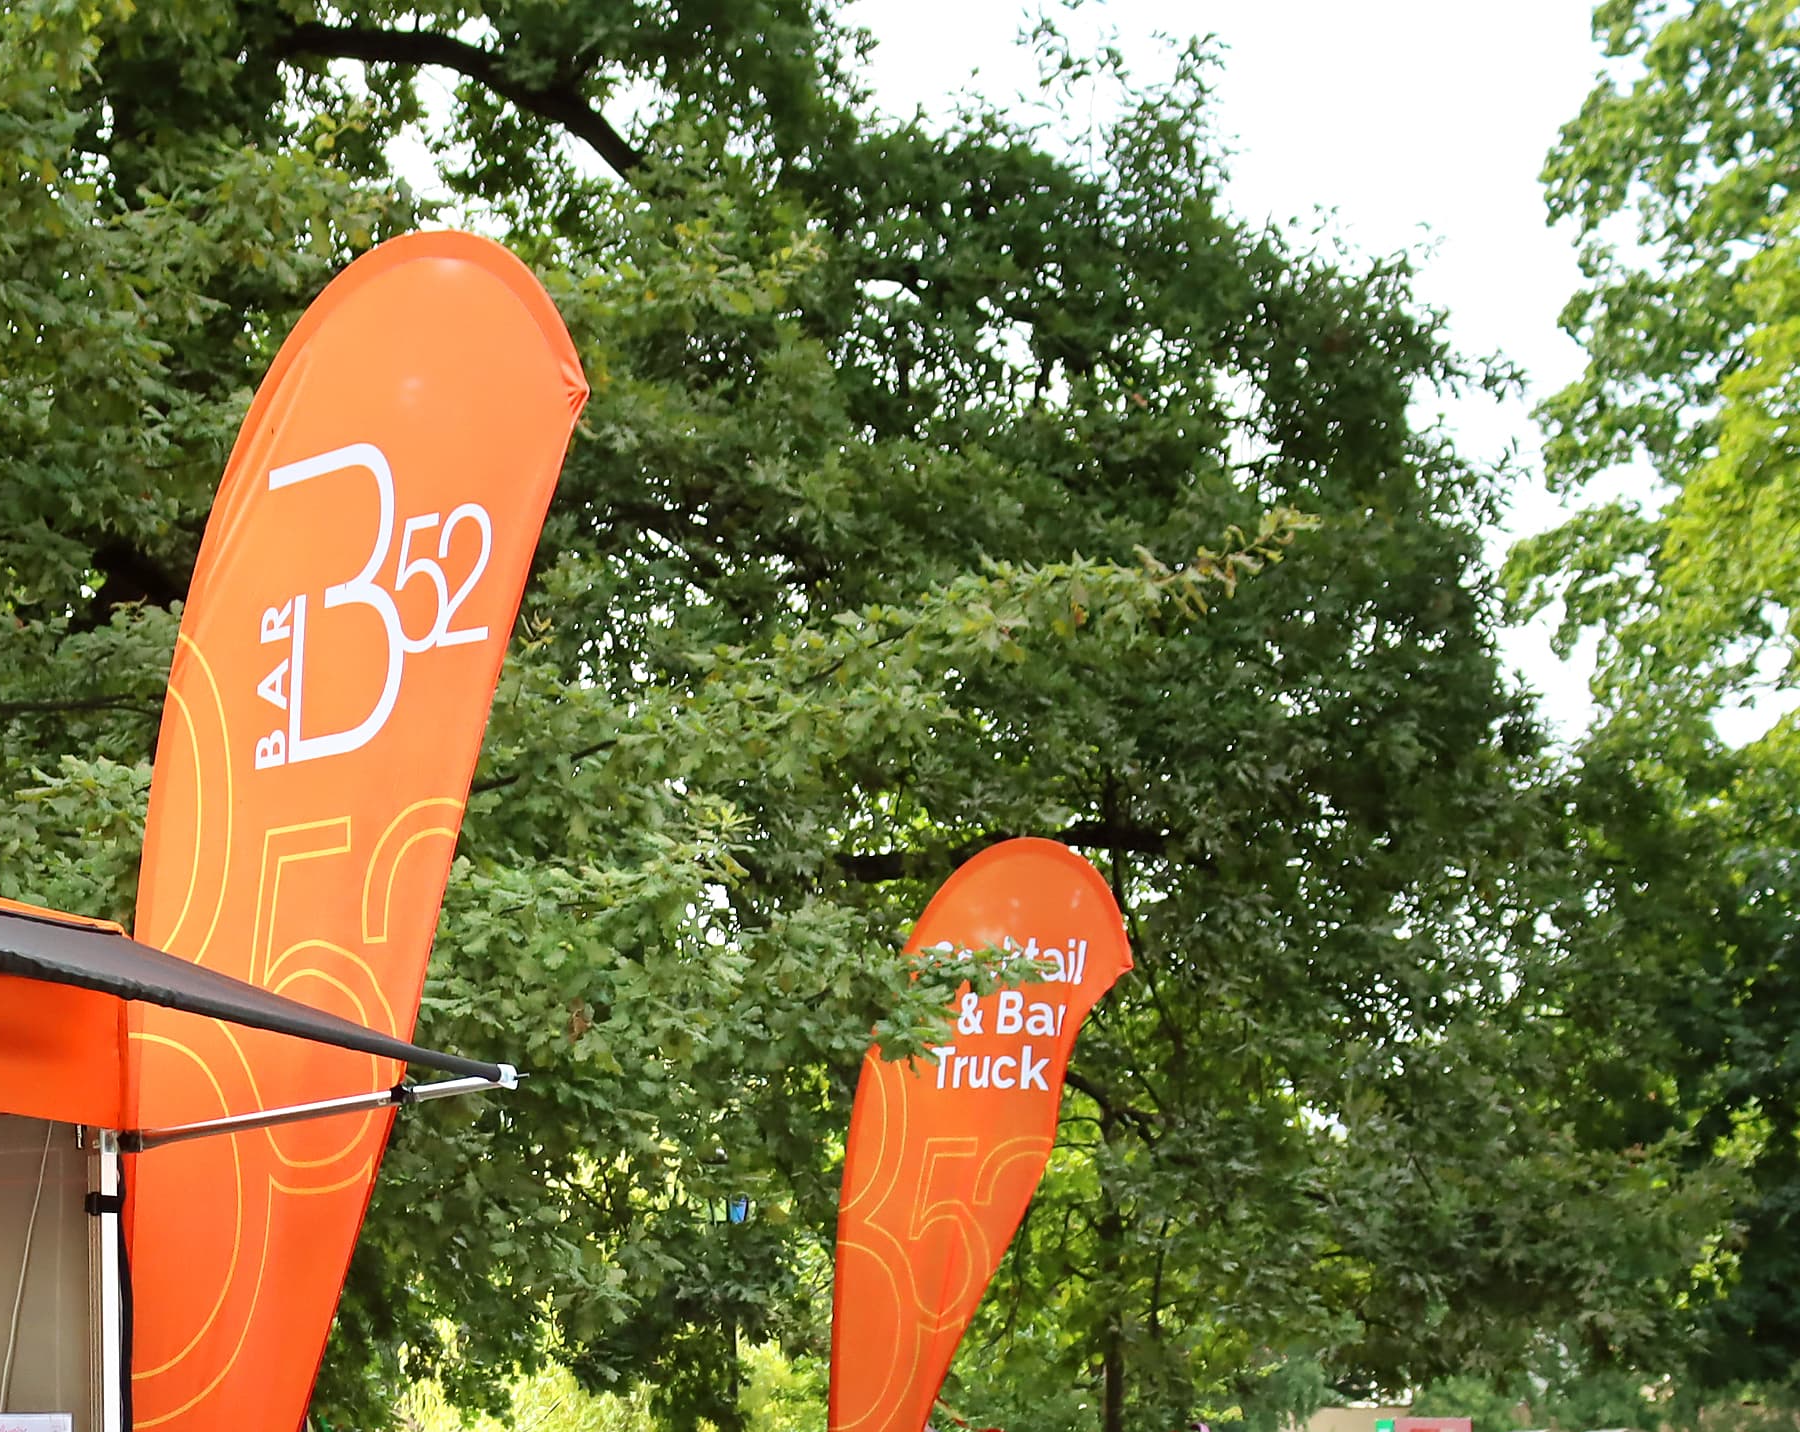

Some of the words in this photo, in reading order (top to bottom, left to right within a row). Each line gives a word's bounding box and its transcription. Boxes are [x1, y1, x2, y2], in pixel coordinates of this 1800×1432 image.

[268, 442, 492, 764] B52
[255, 598, 292, 770] BAR
[931, 1045, 1051, 1091] Truck
[957, 991, 985, 1036] &
